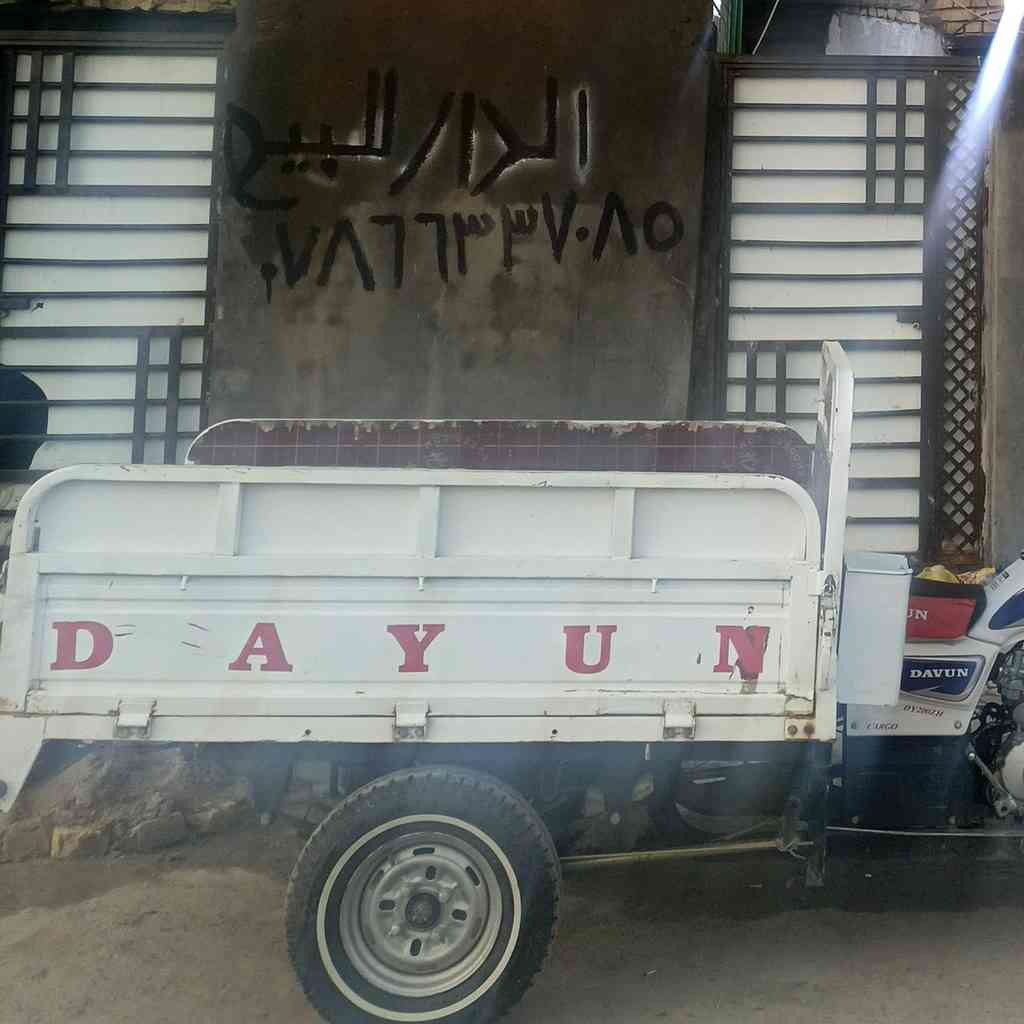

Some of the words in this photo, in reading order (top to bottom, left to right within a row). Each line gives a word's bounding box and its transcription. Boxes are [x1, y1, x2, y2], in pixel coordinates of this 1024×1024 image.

[223, 69, 397, 210] للبيع
[389, 74, 591, 197] الدار
[49, 620, 770, 675] DAYUN
